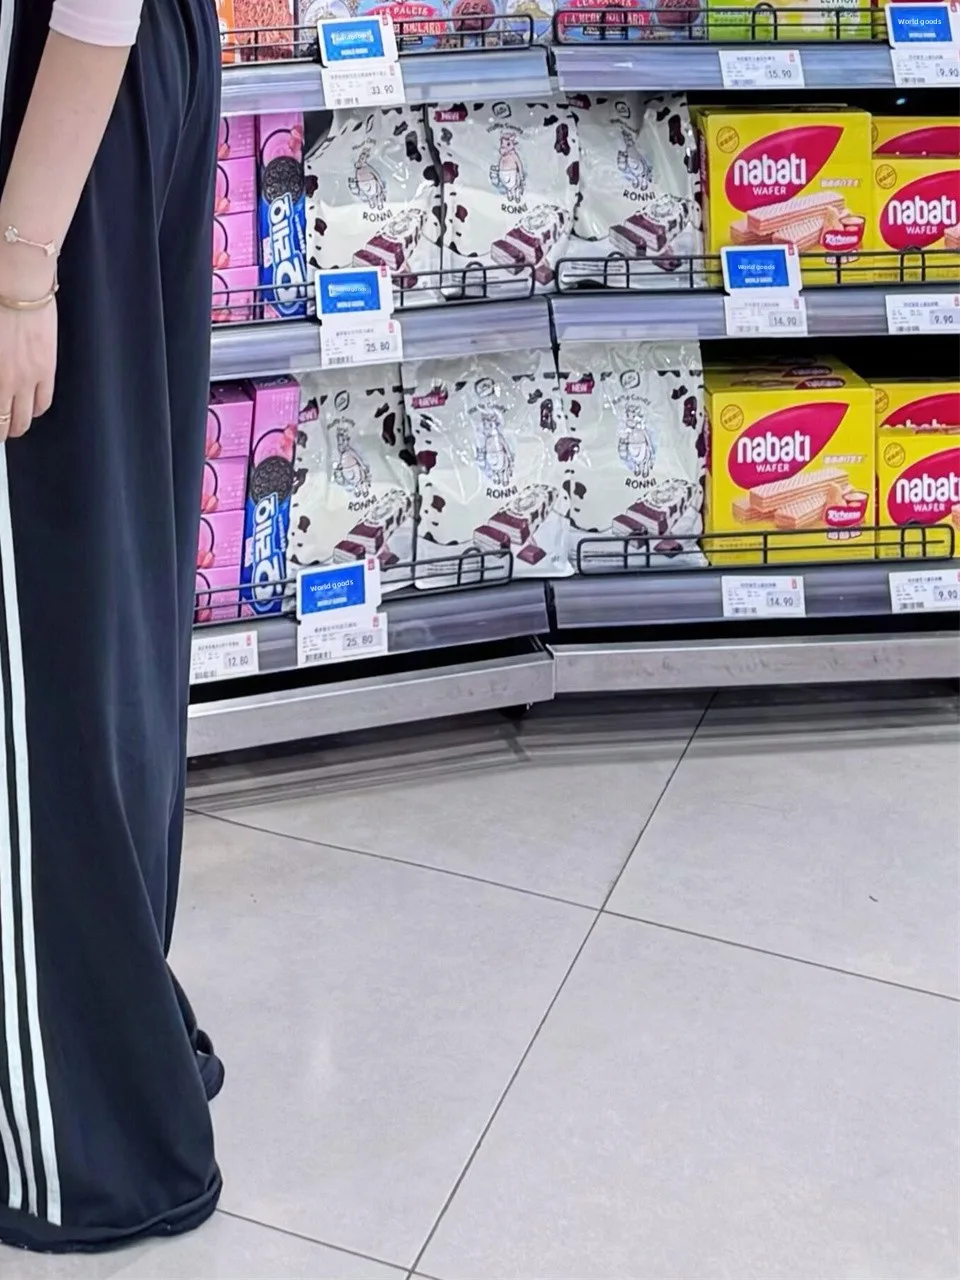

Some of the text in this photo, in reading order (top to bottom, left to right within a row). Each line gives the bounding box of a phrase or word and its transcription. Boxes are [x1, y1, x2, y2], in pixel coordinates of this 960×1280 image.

[768, 69, 792, 79] 15.90
[939, 68, 959, 78] 9.90
[733, 152, 807, 187] nabati
[623, 190, 656, 202] RONNI
[752, 186, 787, 196] WAFER
[888, 195, 957, 226] nabati
[757, 264, 775, 272] goods
[934, 314, 954, 324] 9.90
[486, 486, 518, 499] RONNI
[348, 495, 378, 512] RONNI
[310, 578, 354, 592] World goods
[346, 634, 373, 647] 25.80
[227, 655, 249, 666] 12.80
